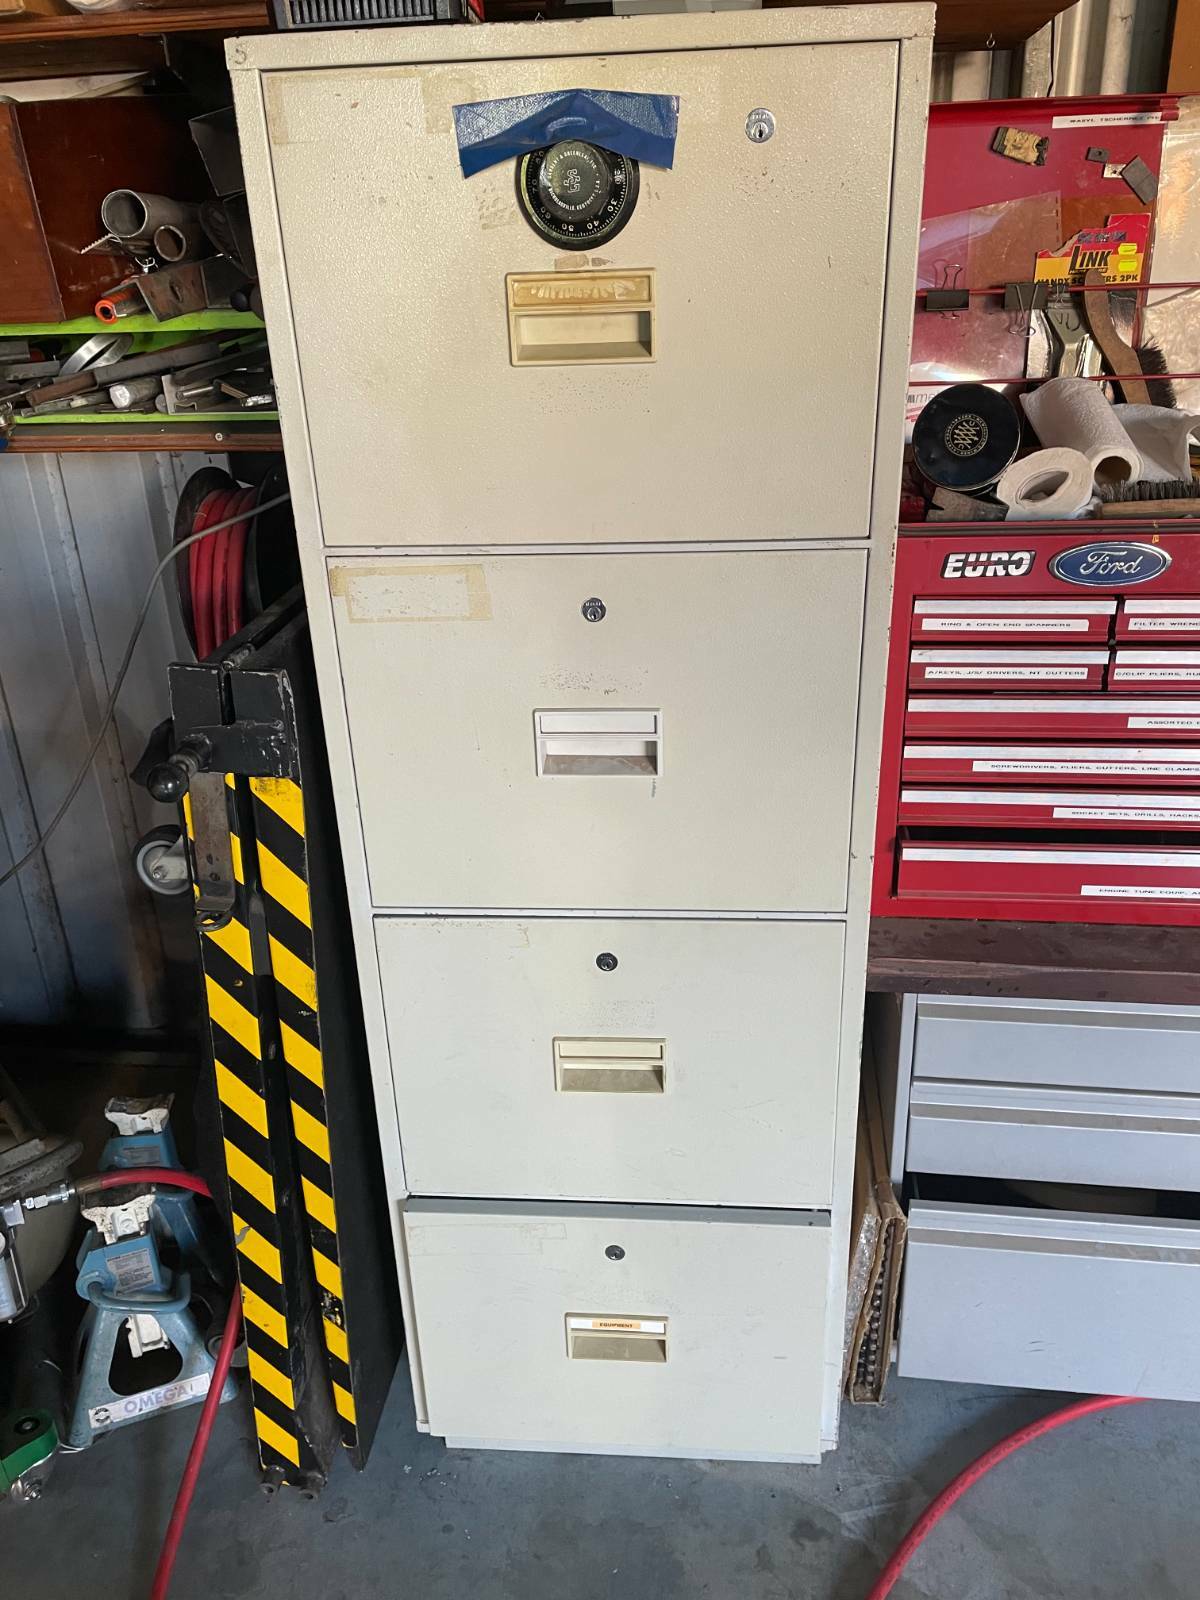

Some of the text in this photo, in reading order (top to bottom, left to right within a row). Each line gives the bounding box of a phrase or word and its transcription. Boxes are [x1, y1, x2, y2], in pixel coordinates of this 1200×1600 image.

[607, 198, 617, 212] 30
[561, 223, 575, 232] 50
[586, 220, 600, 230] 40
[1069, 245, 1112, 273] LINK
[1119, 274, 1139, 283] 2PK
[943, 551, 1031, 578] EURO
[1080, 551, 1144, 575] Ford
[124, 1385, 189, 1413] OMEGA
